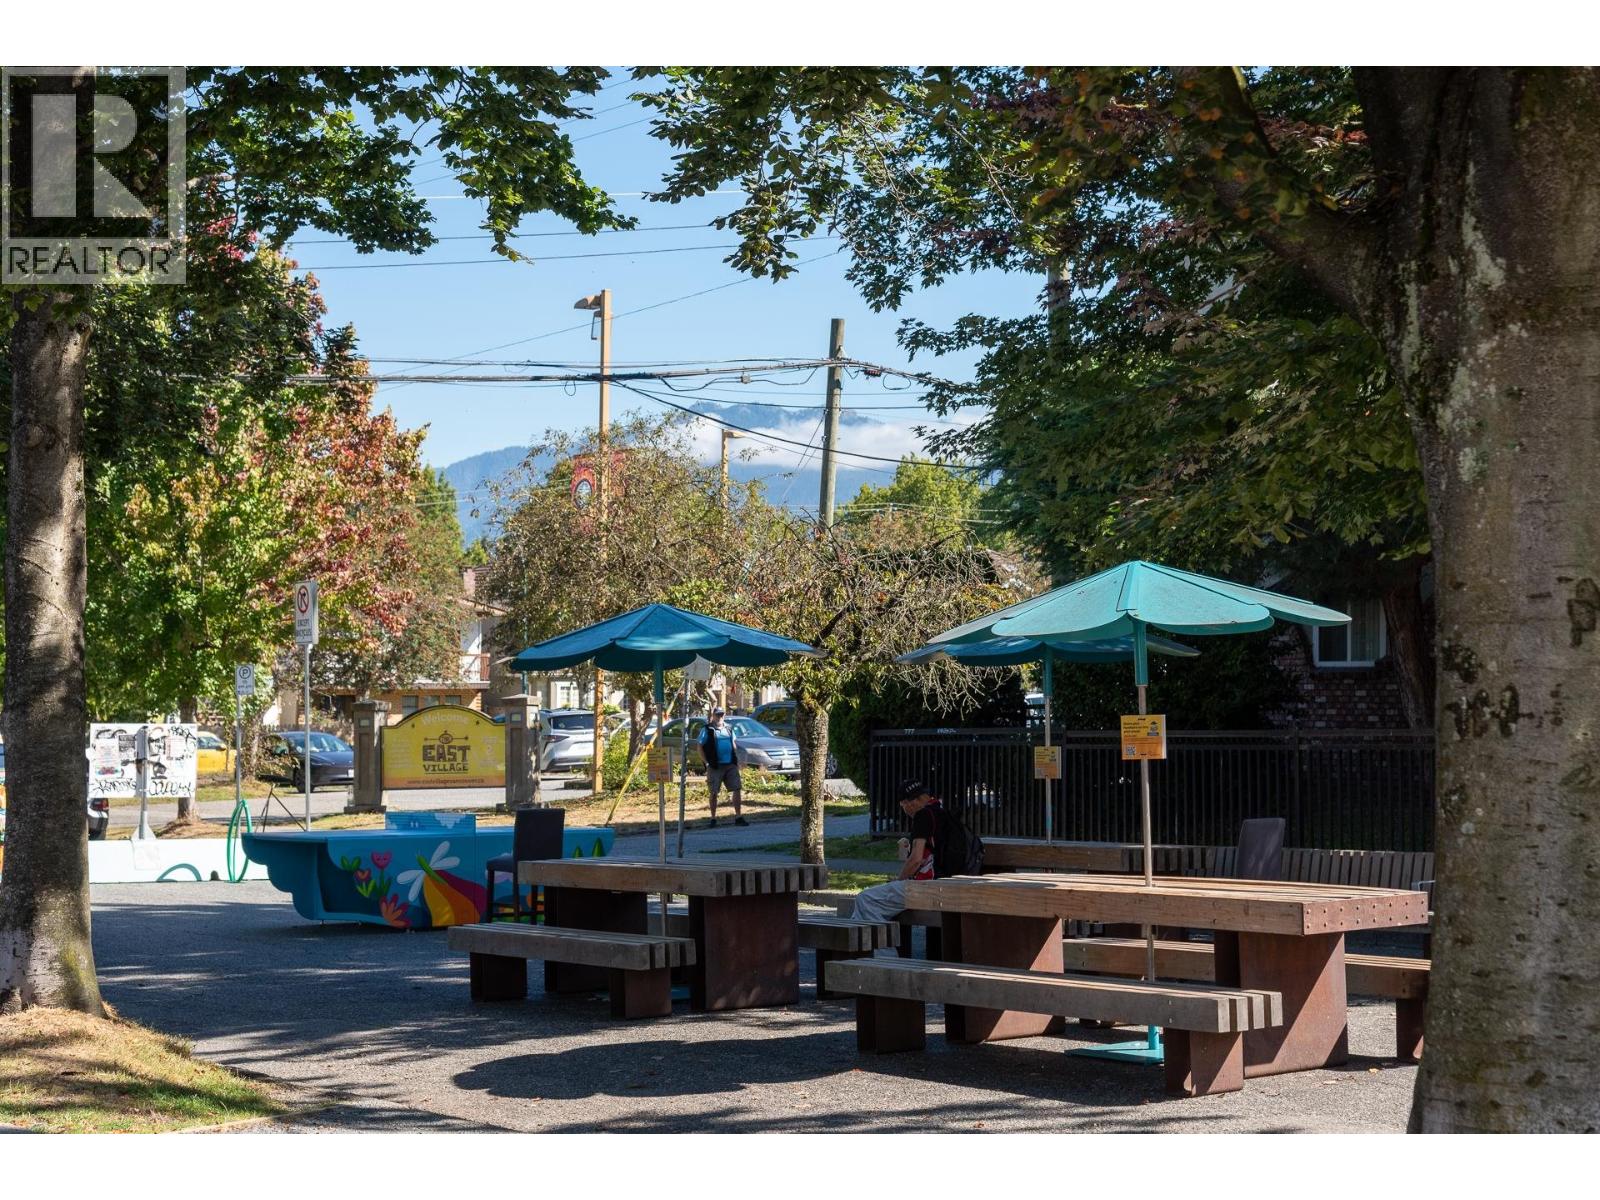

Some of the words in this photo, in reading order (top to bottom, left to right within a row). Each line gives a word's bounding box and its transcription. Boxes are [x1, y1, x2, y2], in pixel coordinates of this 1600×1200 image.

[422, 711, 469, 726] Welcome
[422, 744, 471, 762] EAST
[423, 763, 469, 772] VILLAGE
